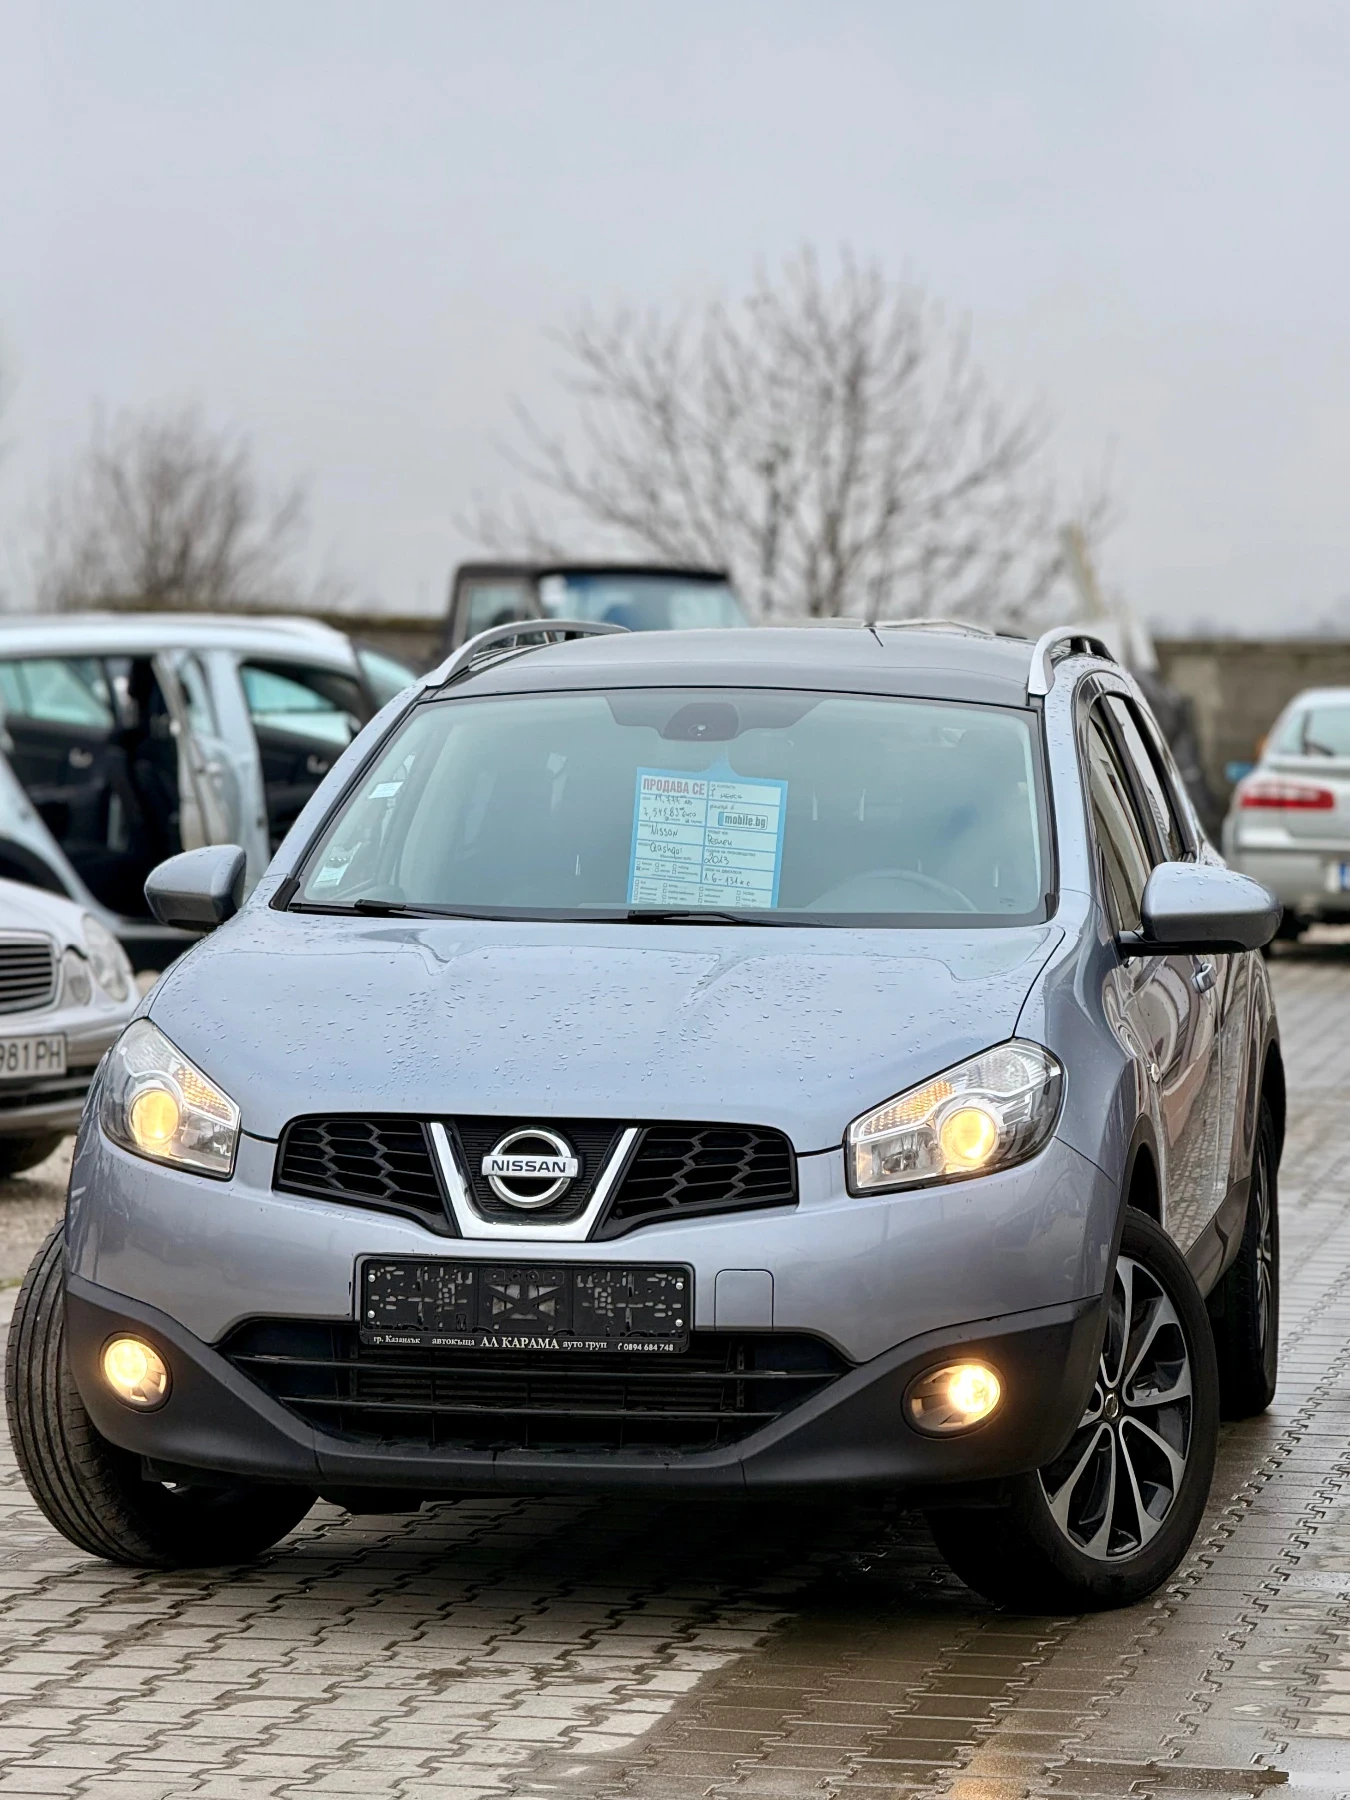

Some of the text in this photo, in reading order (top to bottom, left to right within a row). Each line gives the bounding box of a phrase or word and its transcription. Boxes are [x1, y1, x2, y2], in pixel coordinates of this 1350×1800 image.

[643, 778, 689, 794] ПРОДАВА
[692, 782, 705, 795] СЕ
[724, 814, 766, 829] mobile.bg
[704, 852, 730, 865] 2013
[491, 1159, 567, 1173] NISSAN
[373, 1335, 384, 1344] гр.
[385, 1335, 421, 1344] Казанлък
[431, 1338, 475, 1346] автокъща
[480, 1336, 500, 1348] АЛ
[501, 1336, 560, 1349] КАРАМА
[562, 1341, 583, 1349] ауто
[585, 1341, 608, 1351] груп
[623, 1343, 643, 1351] 0894
